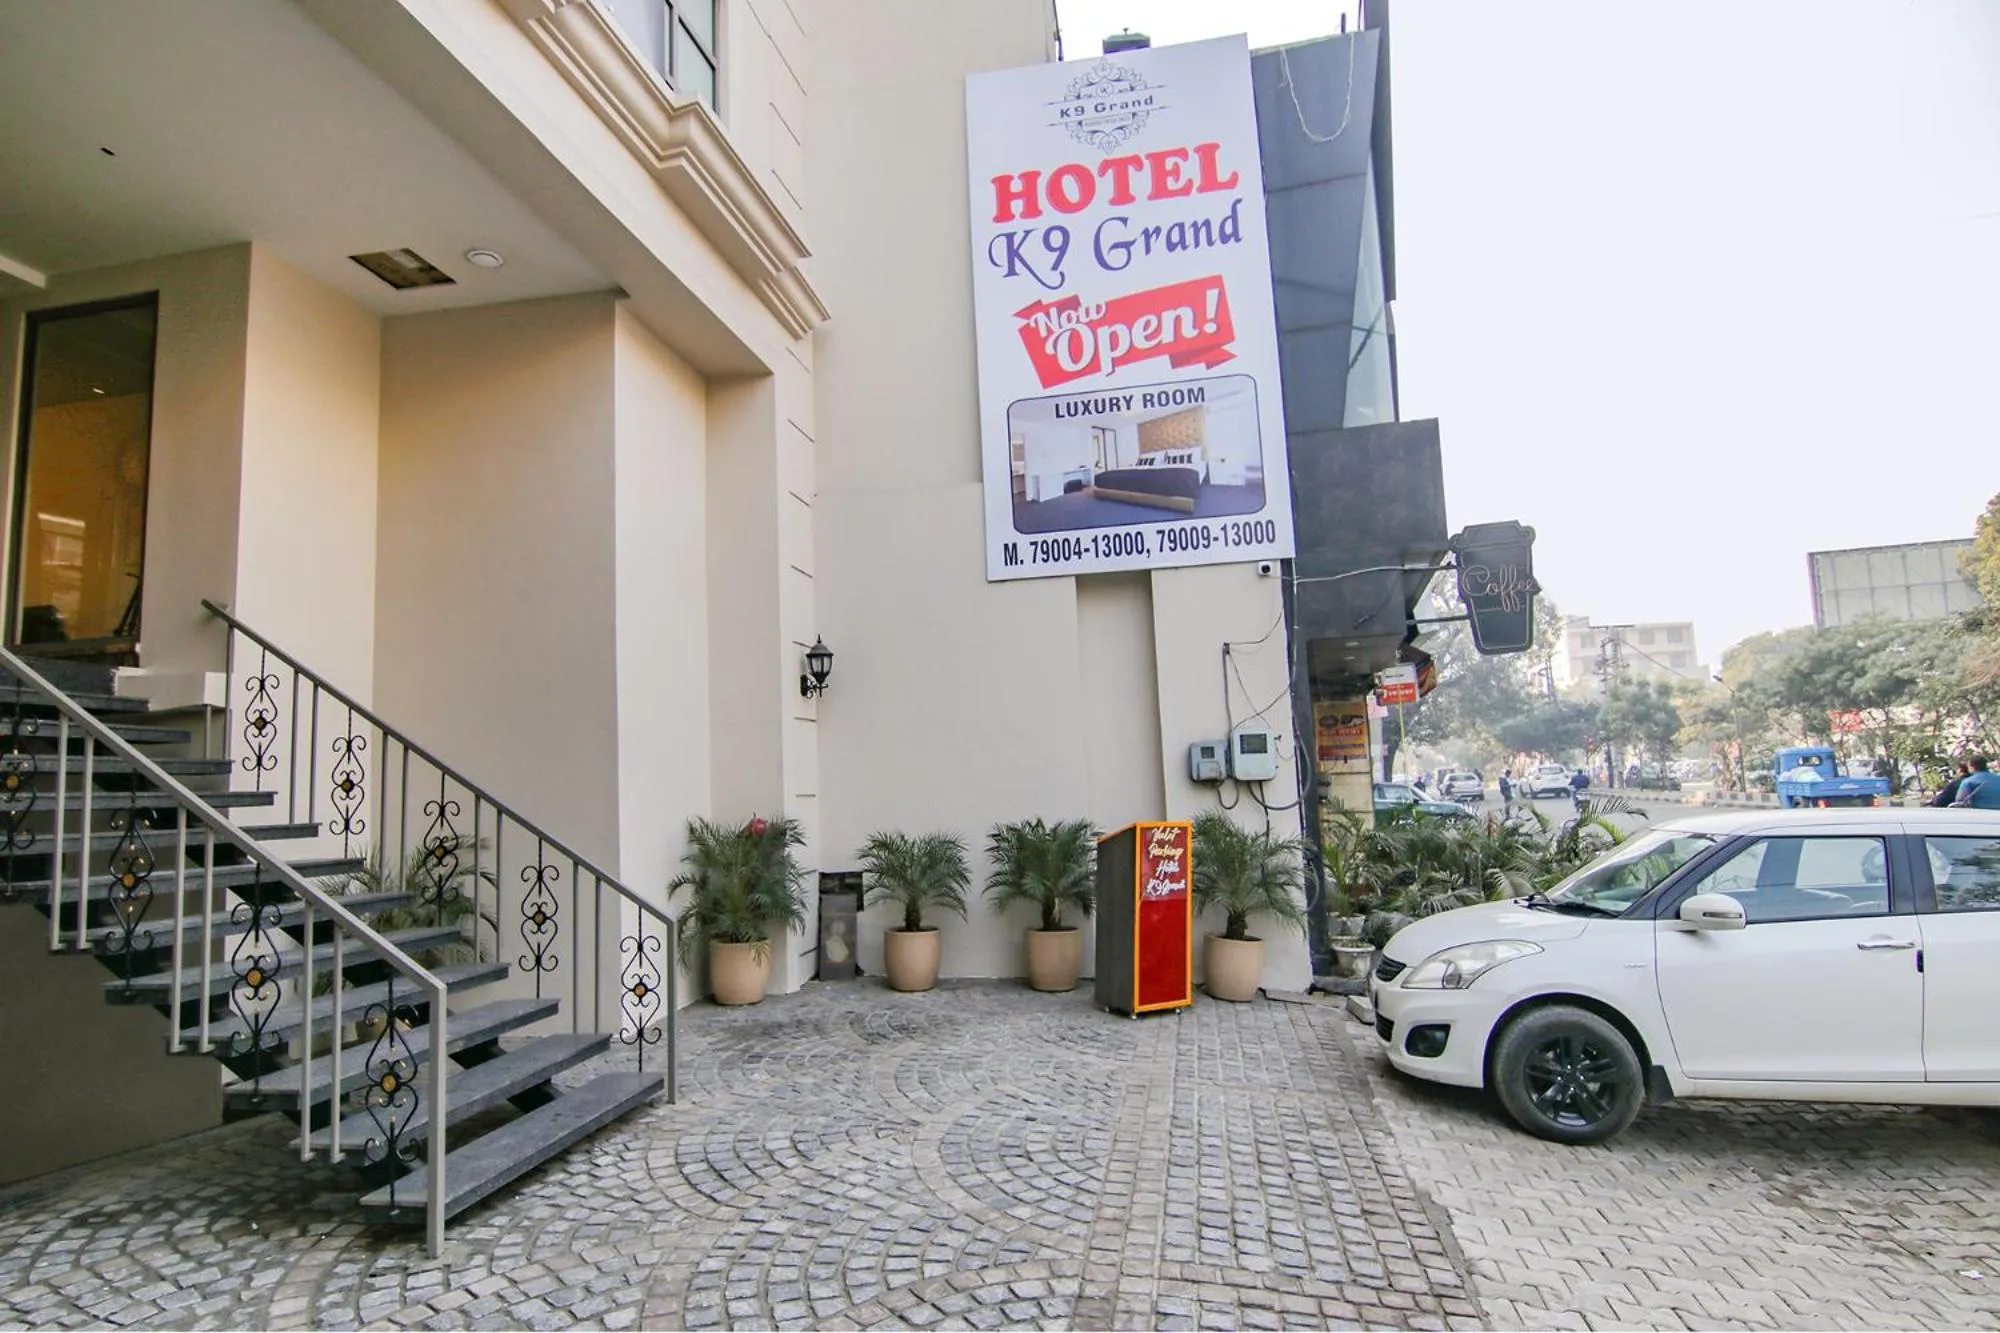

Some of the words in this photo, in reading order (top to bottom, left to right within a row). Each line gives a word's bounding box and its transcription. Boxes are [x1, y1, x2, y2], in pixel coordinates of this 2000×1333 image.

[1060, 106, 1085, 118] K9
[1094, 95, 1153, 113] Grand
[990, 142, 1239, 224] HOTEL
[988, 224, 1071, 290] K9
[1093, 198, 1244, 271] Grand
[1030, 300, 1108, 337] Now
[1045, 288, 1221, 377] Open!
[1055, 395, 1134, 419] LUXURY
[1143, 387, 1205, 409] ROOM
[1003, 542, 1024, 566] M.
[1029, 531, 1151, 564] 79004-13000,
[1156, 519, 1276, 552] 79009-13000
[1462, 564, 1535, 613] Coffee
[1148, 843, 1185, 861] Parking
[1155, 859, 1180, 880] Hotel
